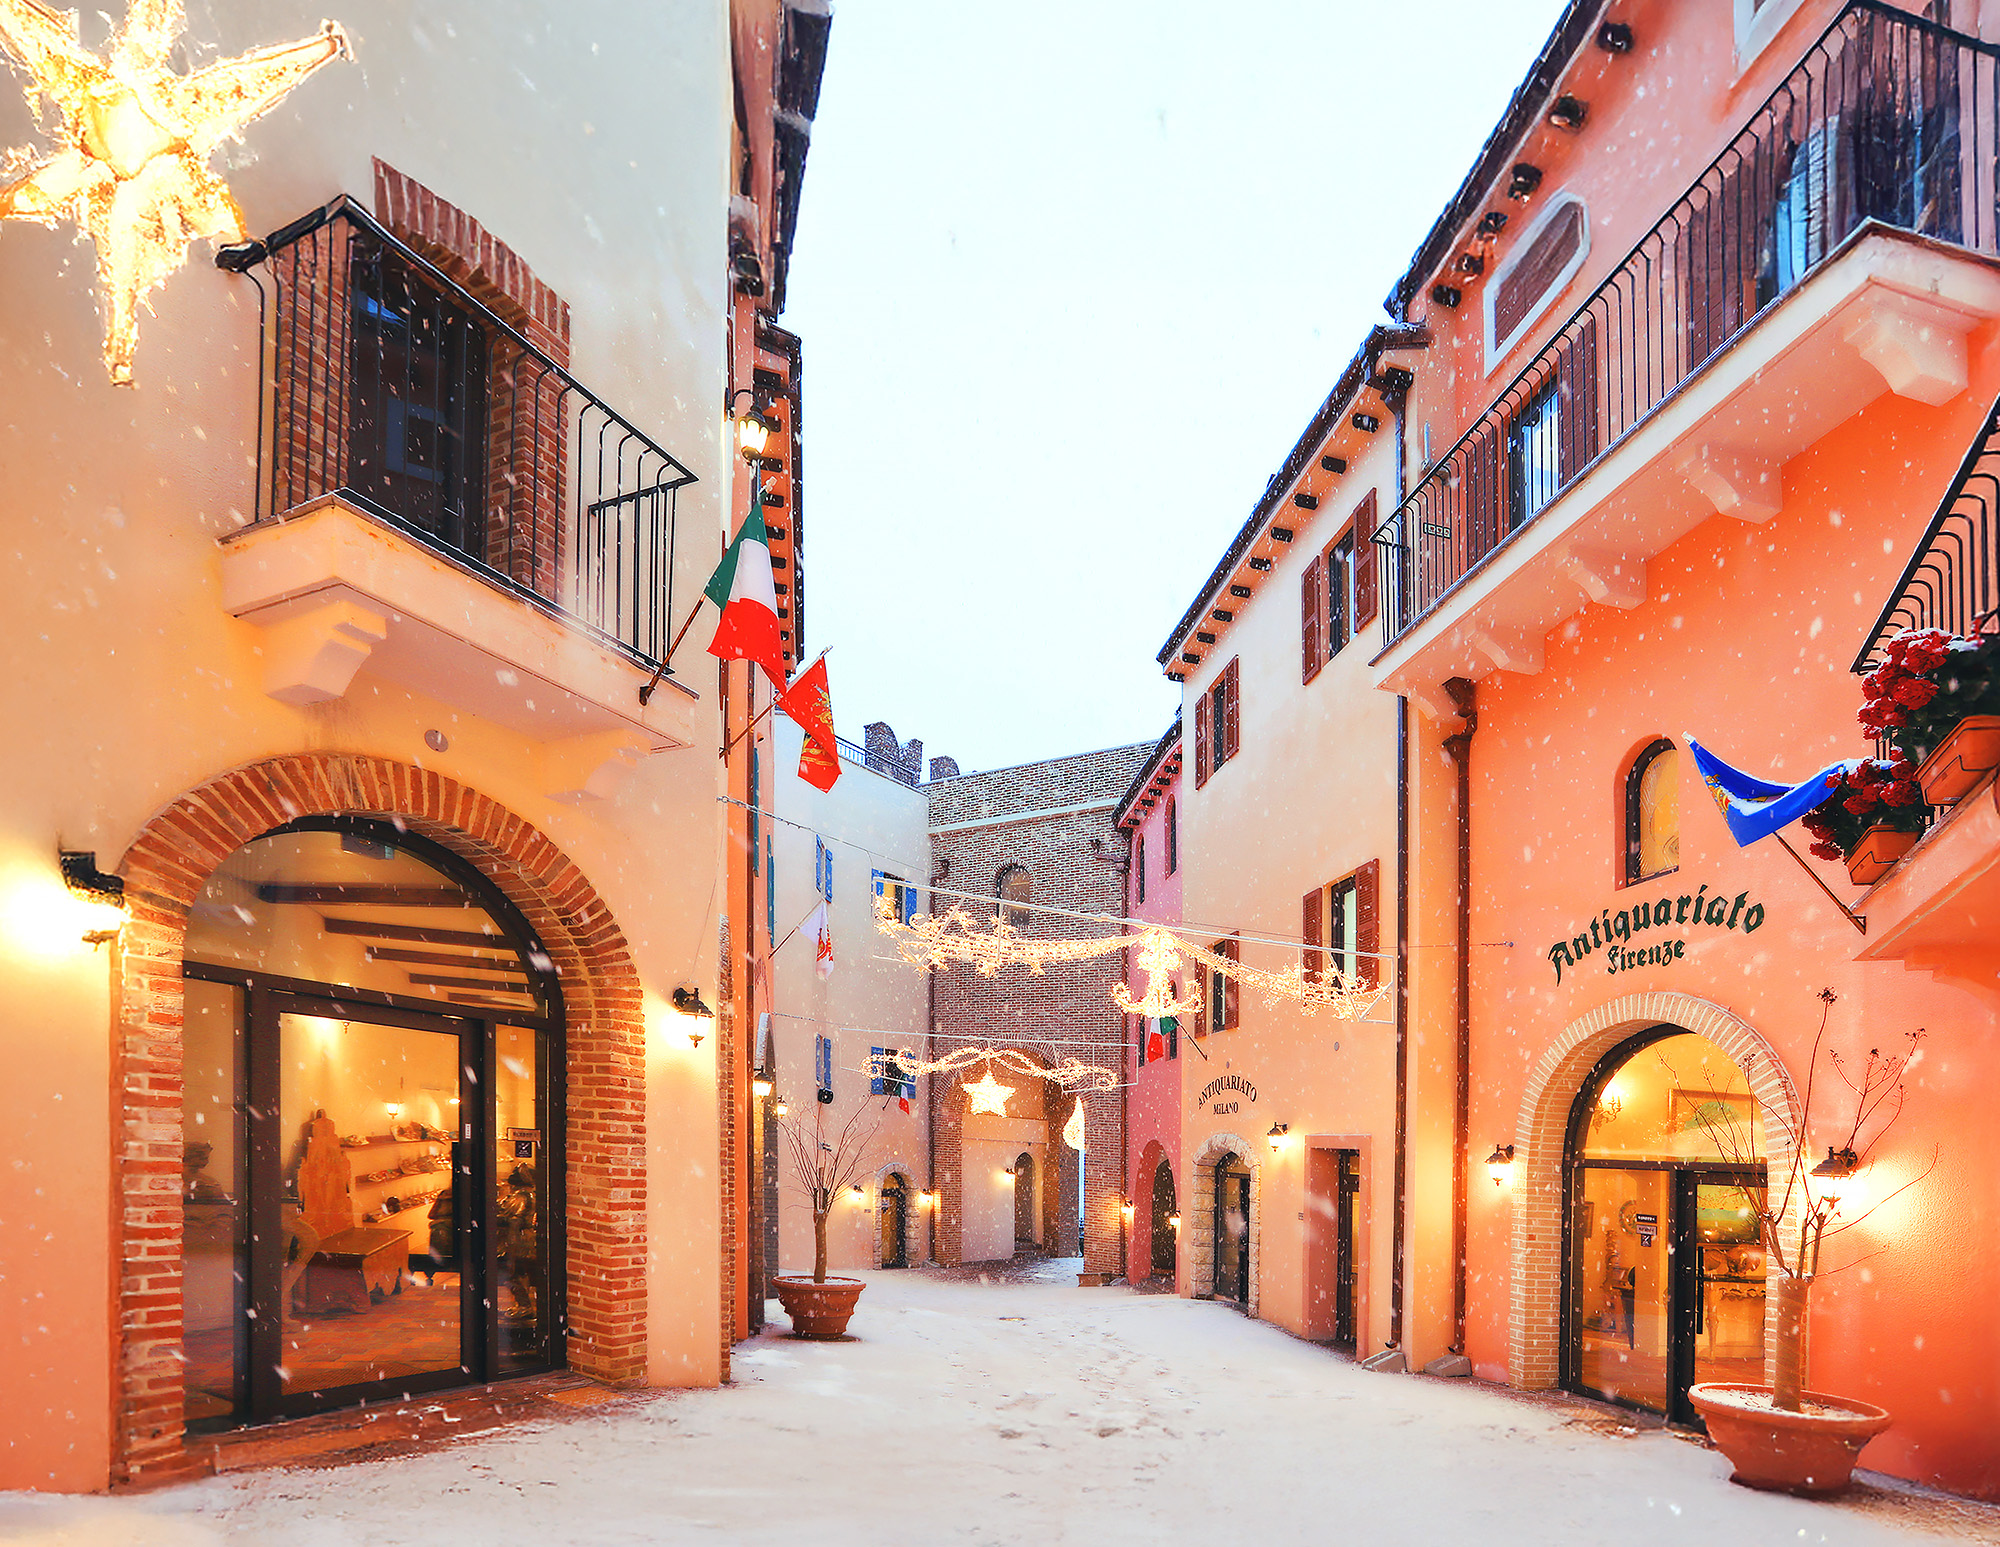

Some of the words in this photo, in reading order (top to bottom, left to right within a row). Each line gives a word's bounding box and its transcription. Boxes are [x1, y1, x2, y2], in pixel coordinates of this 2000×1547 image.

[1548, 883, 1765, 987] Antiquariato
[1607, 938, 1686, 975] Firenze
[1198, 1074, 1257, 1110] ANTIQUARIATO
[1213, 1101, 1239, 1115] MILANO
